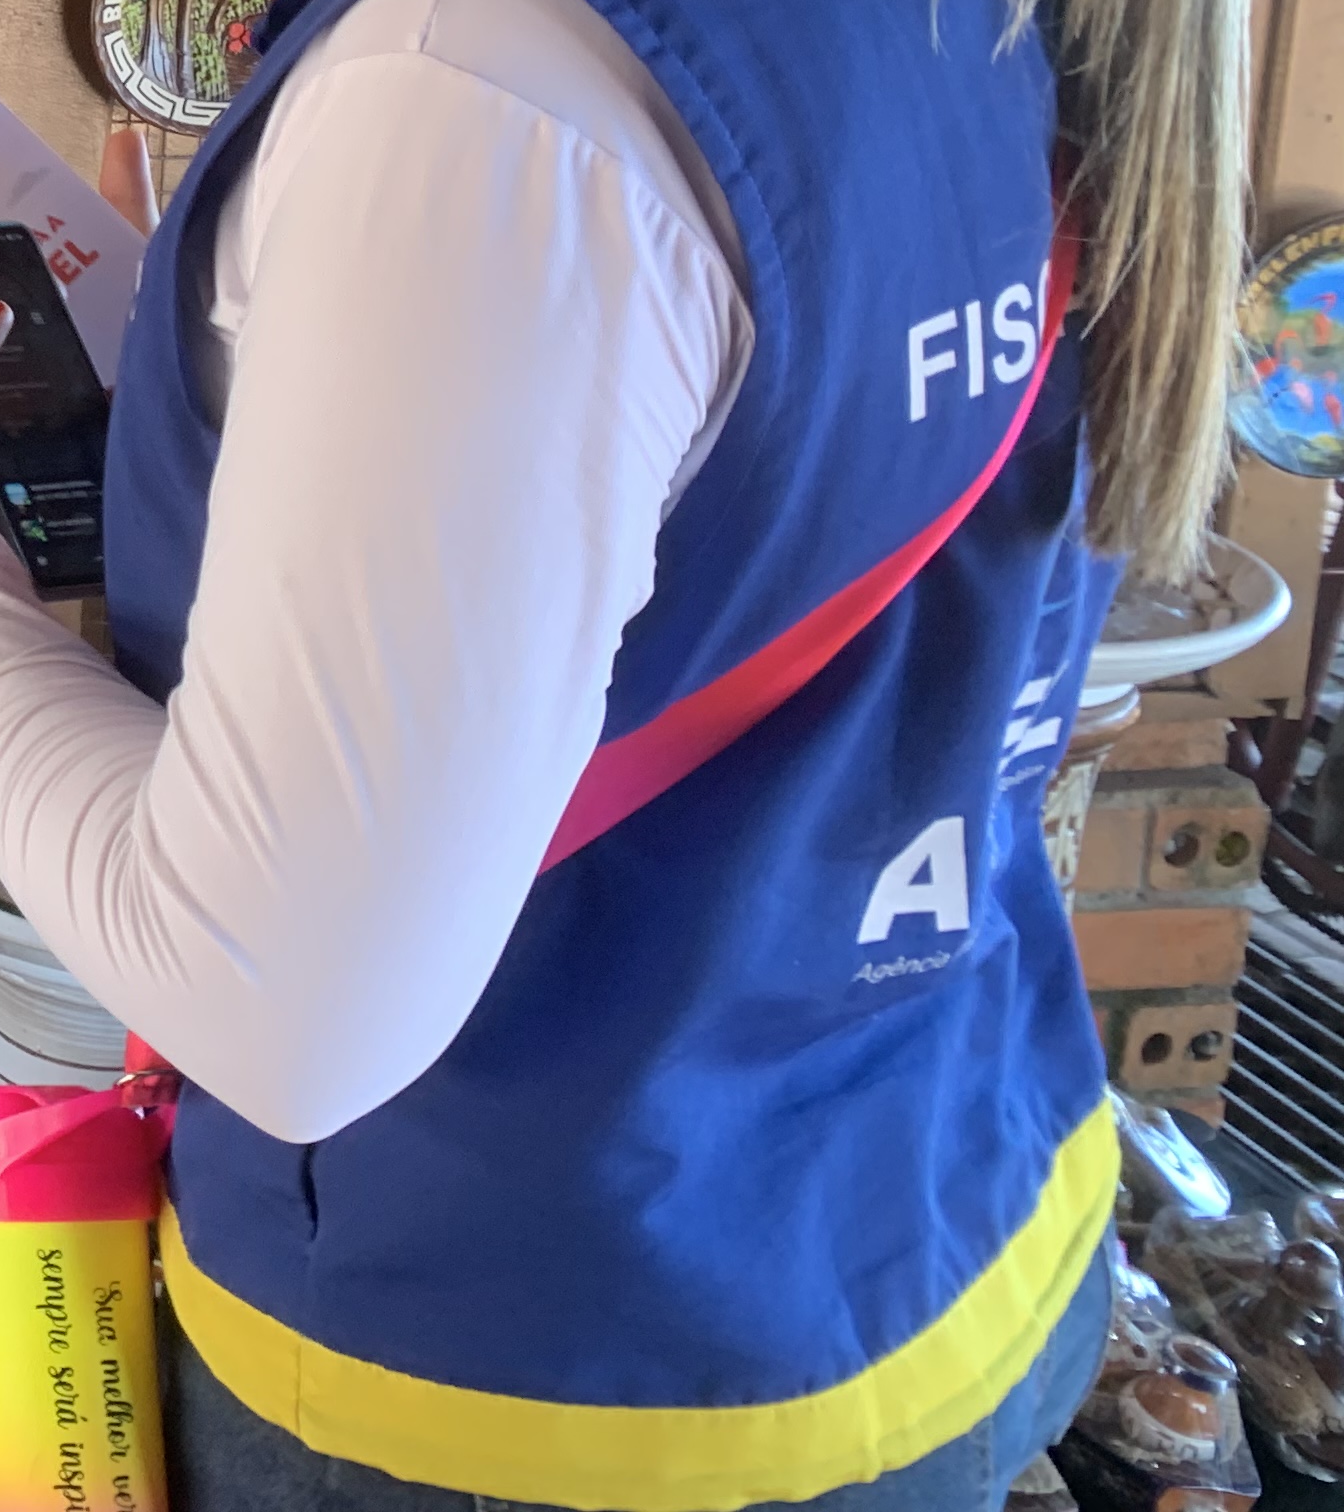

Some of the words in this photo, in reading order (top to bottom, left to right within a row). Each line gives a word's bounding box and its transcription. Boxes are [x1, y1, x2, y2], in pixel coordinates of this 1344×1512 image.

[36, 1248, 73, 1355] sempre
[93, 1280, 123, 1347] Sua
[47, 1365, 89, 1430] será
[100, 1359, 135, 1464] melhor
